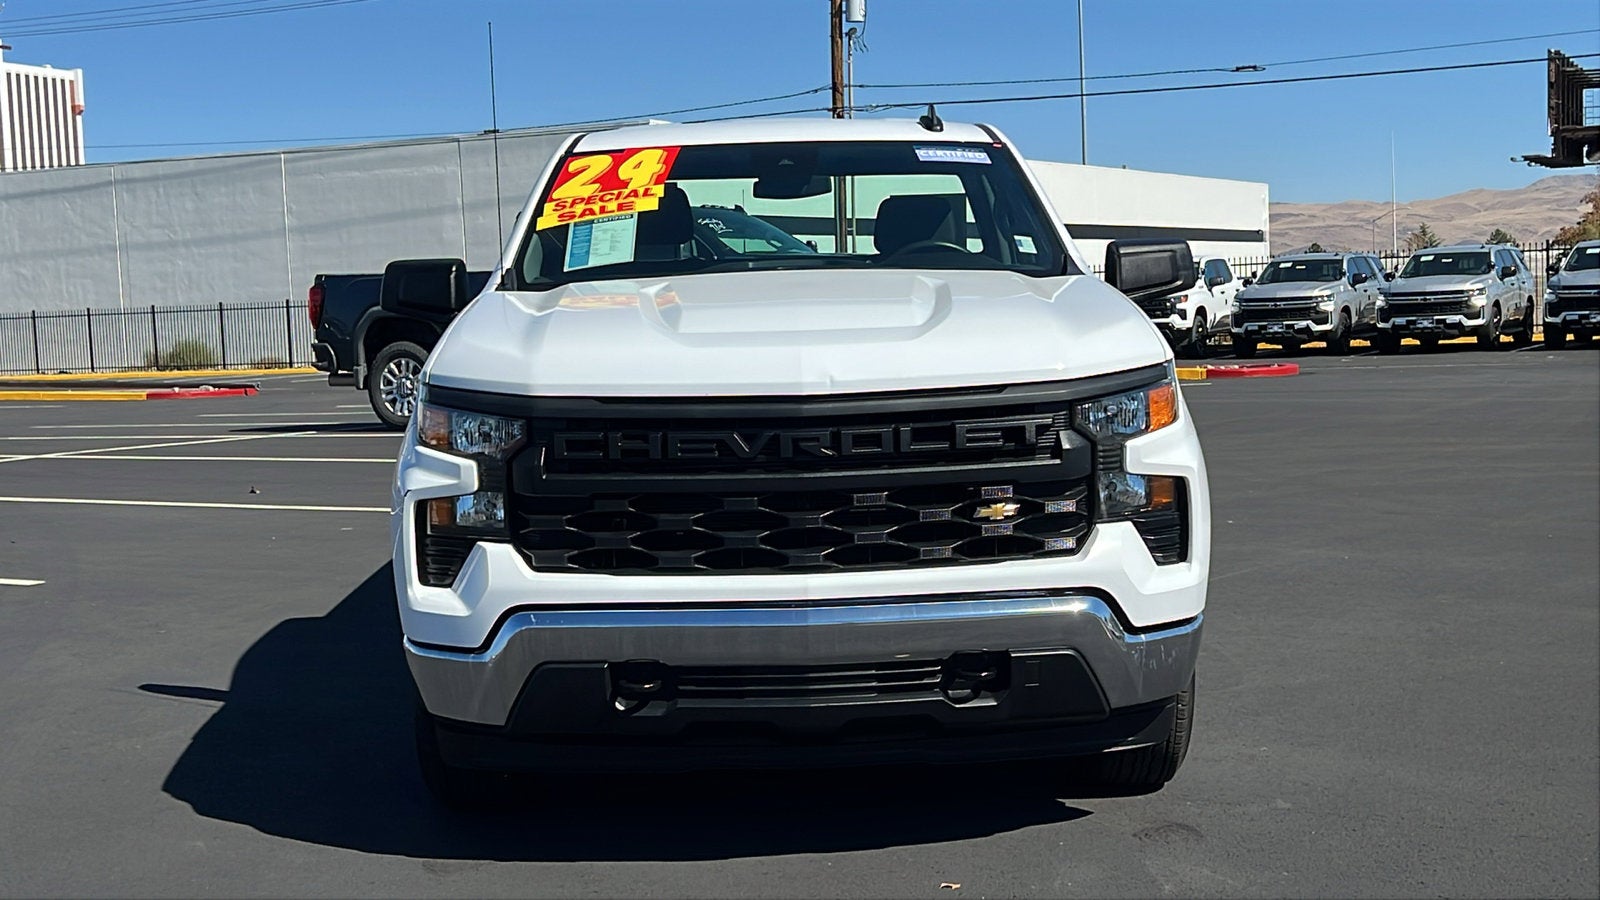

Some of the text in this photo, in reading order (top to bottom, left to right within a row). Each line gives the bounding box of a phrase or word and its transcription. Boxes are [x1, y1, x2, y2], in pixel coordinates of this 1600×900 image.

[920, 149, 985, 160] CERTIFIED
[552, 149, 667, 199] 24
[552, 187, 656, 212] SPECIAL
[557, 201, 634, 223] SALE
[554, 418, 1053, 459] CHEVROLET
